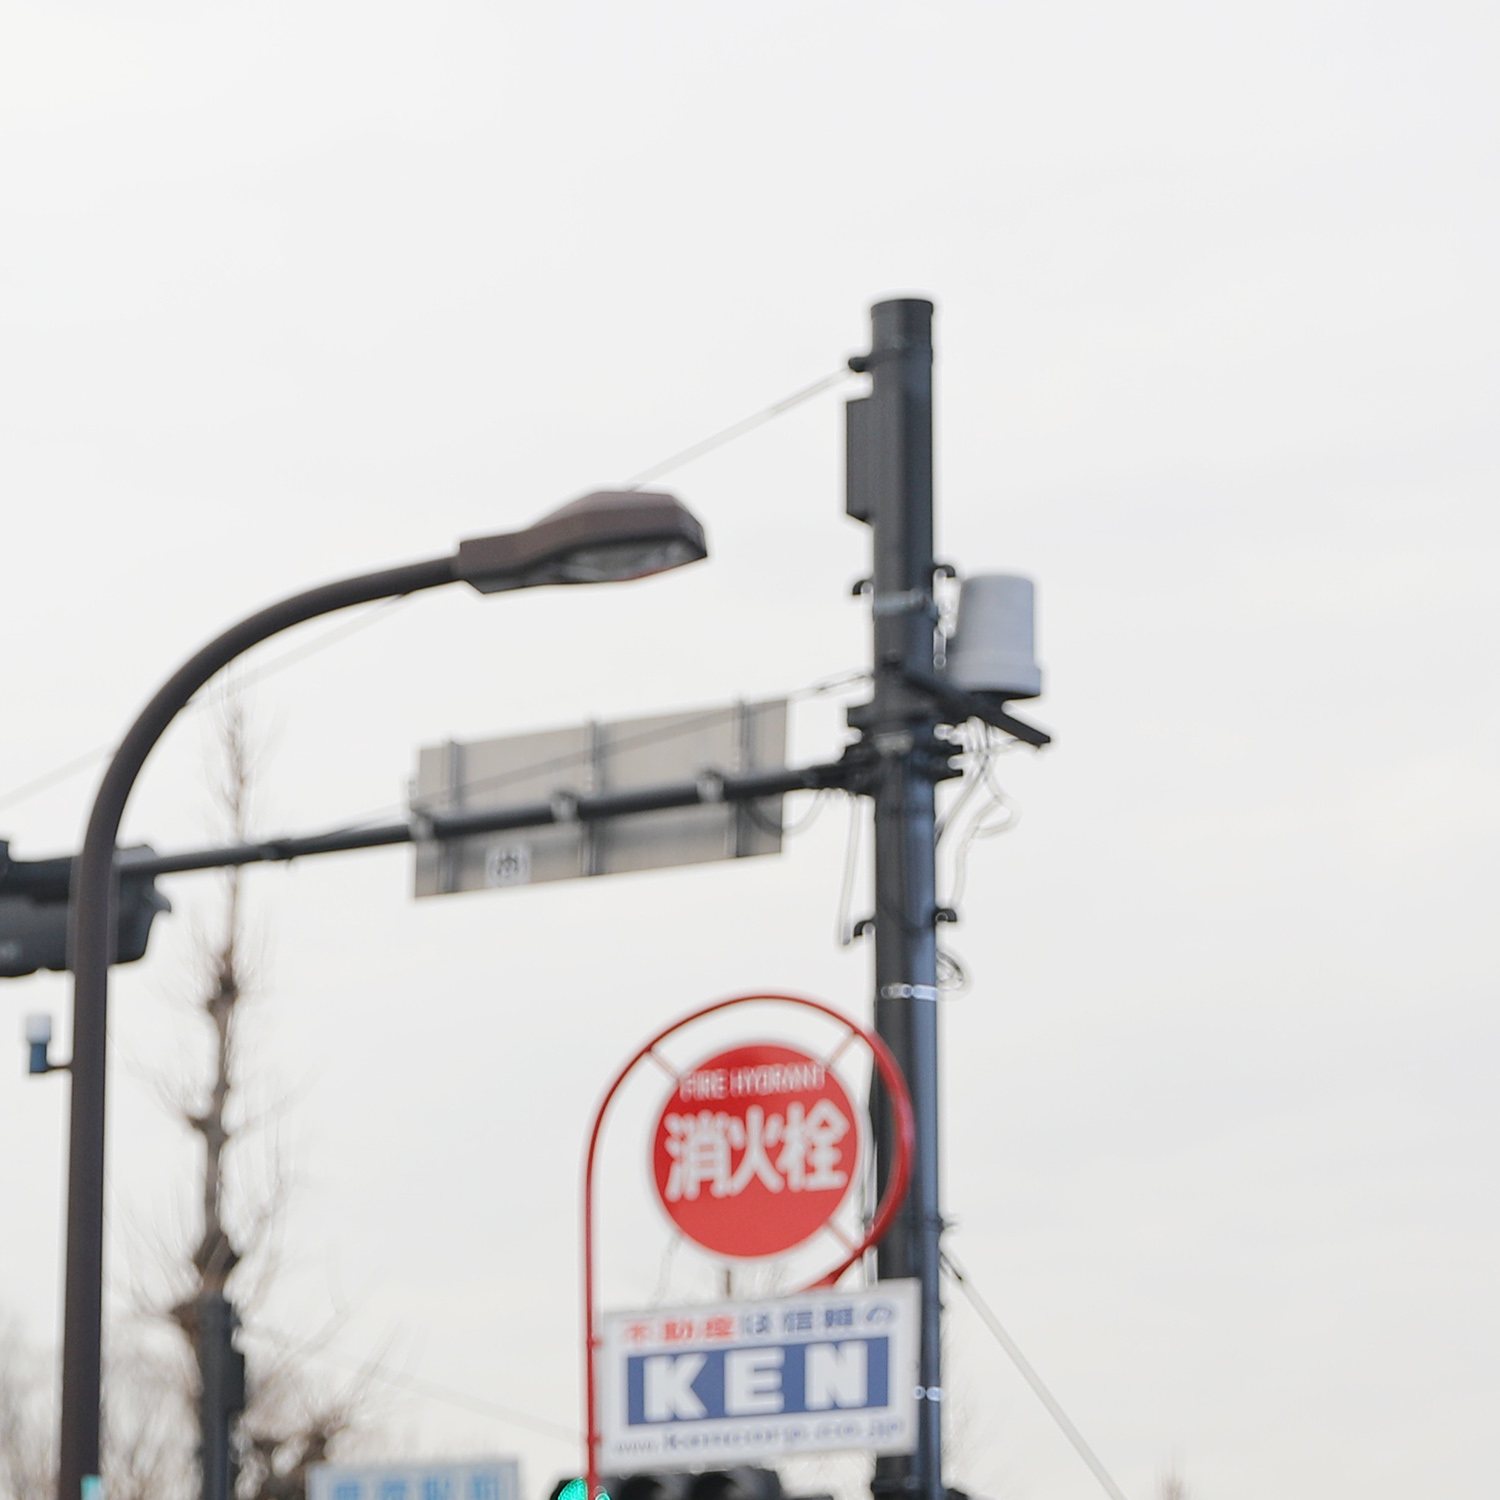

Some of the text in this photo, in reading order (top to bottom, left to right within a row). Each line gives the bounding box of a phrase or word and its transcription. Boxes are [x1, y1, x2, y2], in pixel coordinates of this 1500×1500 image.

[664, 1098, 850, 1203] 消火栓
[643, 1340, 868, 1424] KEN
